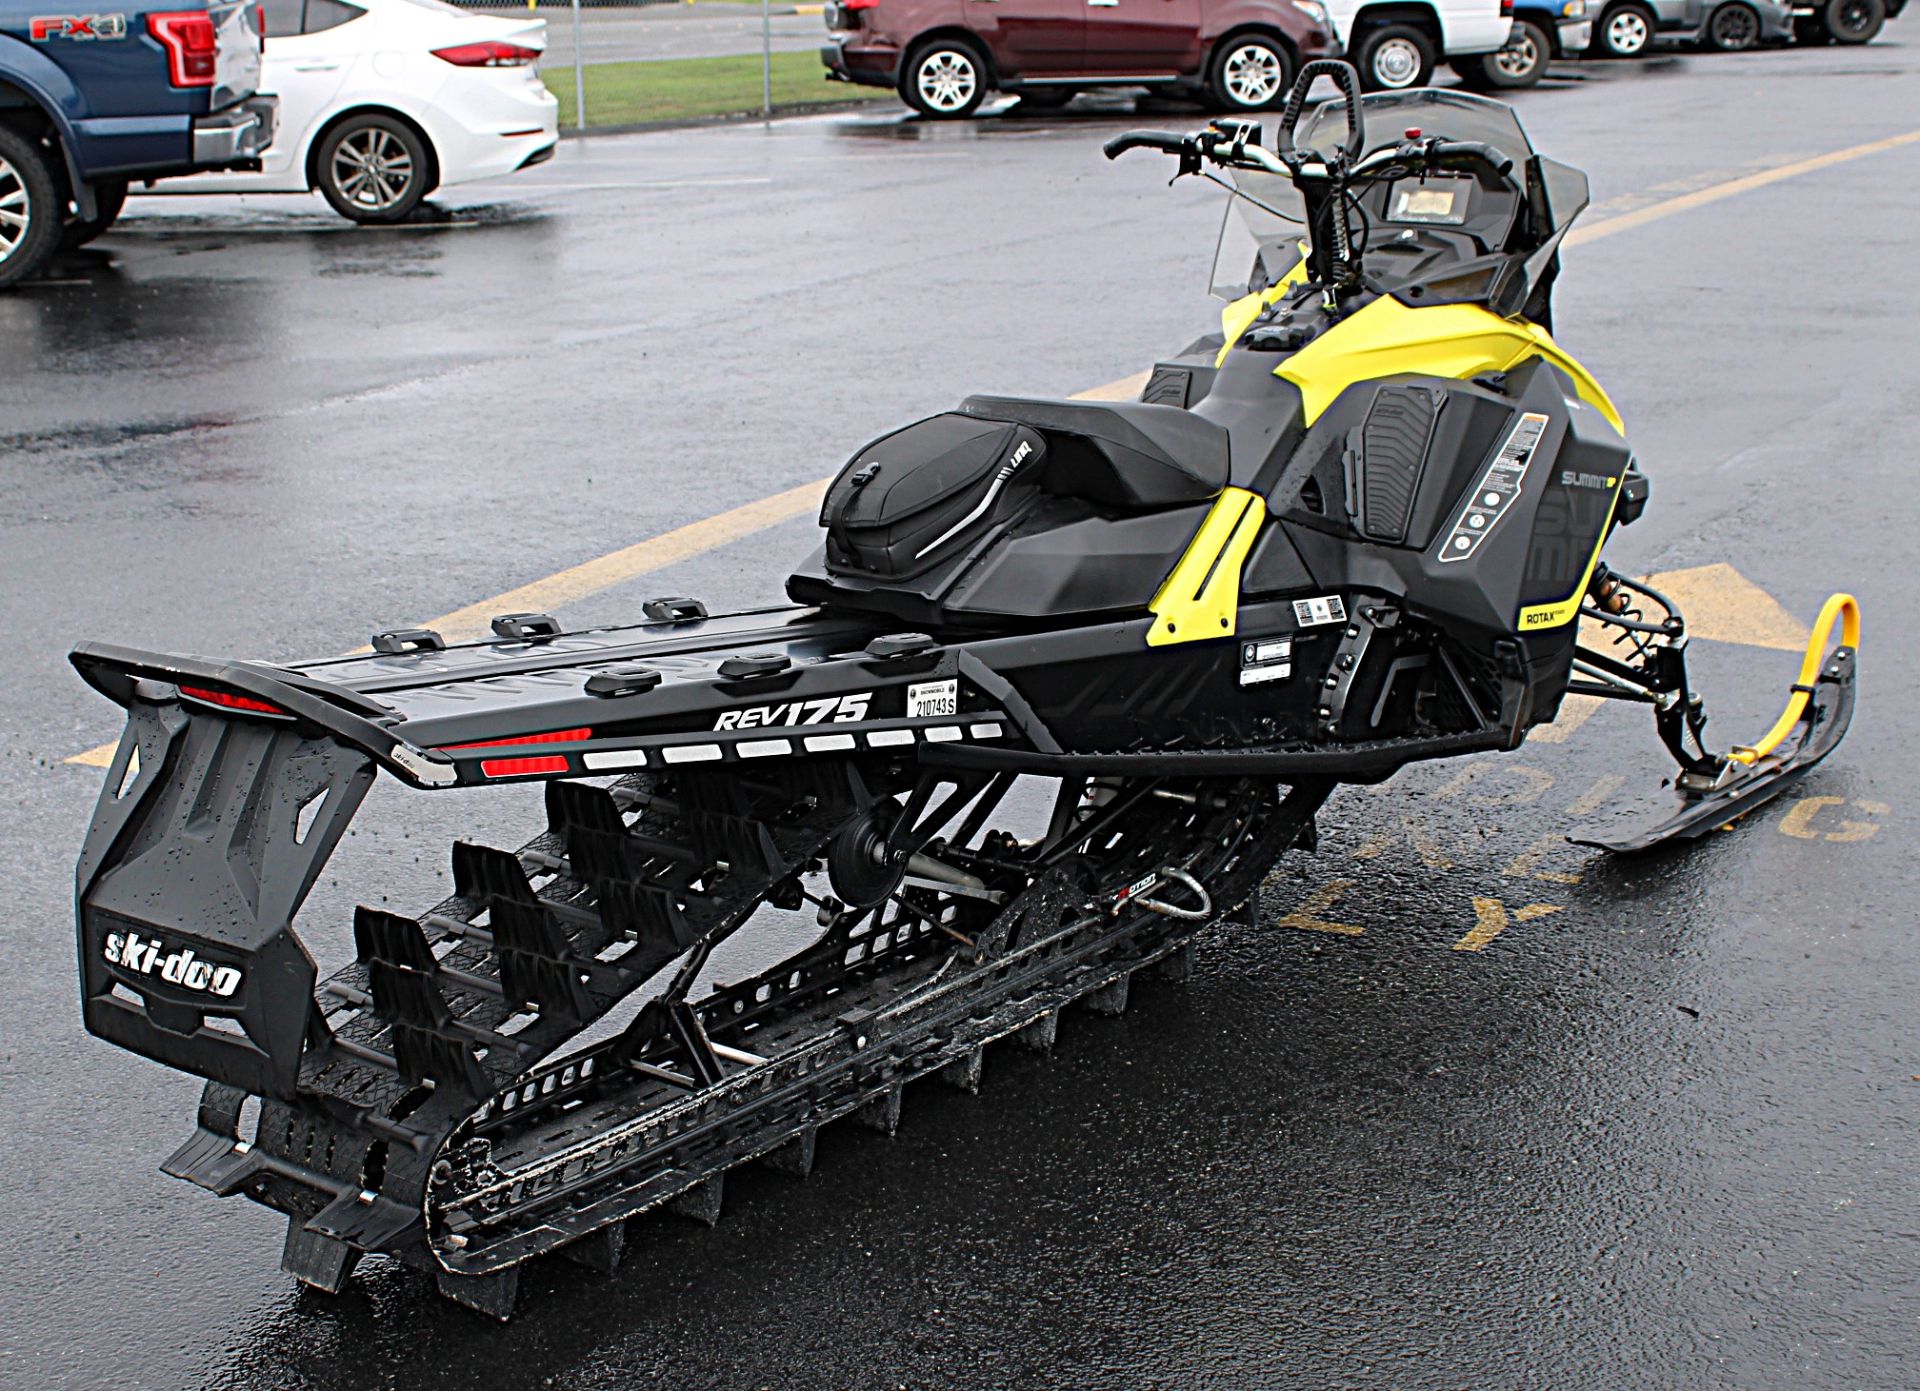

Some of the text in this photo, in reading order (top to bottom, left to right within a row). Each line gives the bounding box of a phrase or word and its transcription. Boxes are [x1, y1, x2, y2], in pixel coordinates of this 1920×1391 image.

[30, 14, 126, 41] FX4
[1562, 470, 1607, 490] SUMMIT
[1526, 611, 1555, 625] ROTAX
[104, 932, 242, 996] ski-doo
